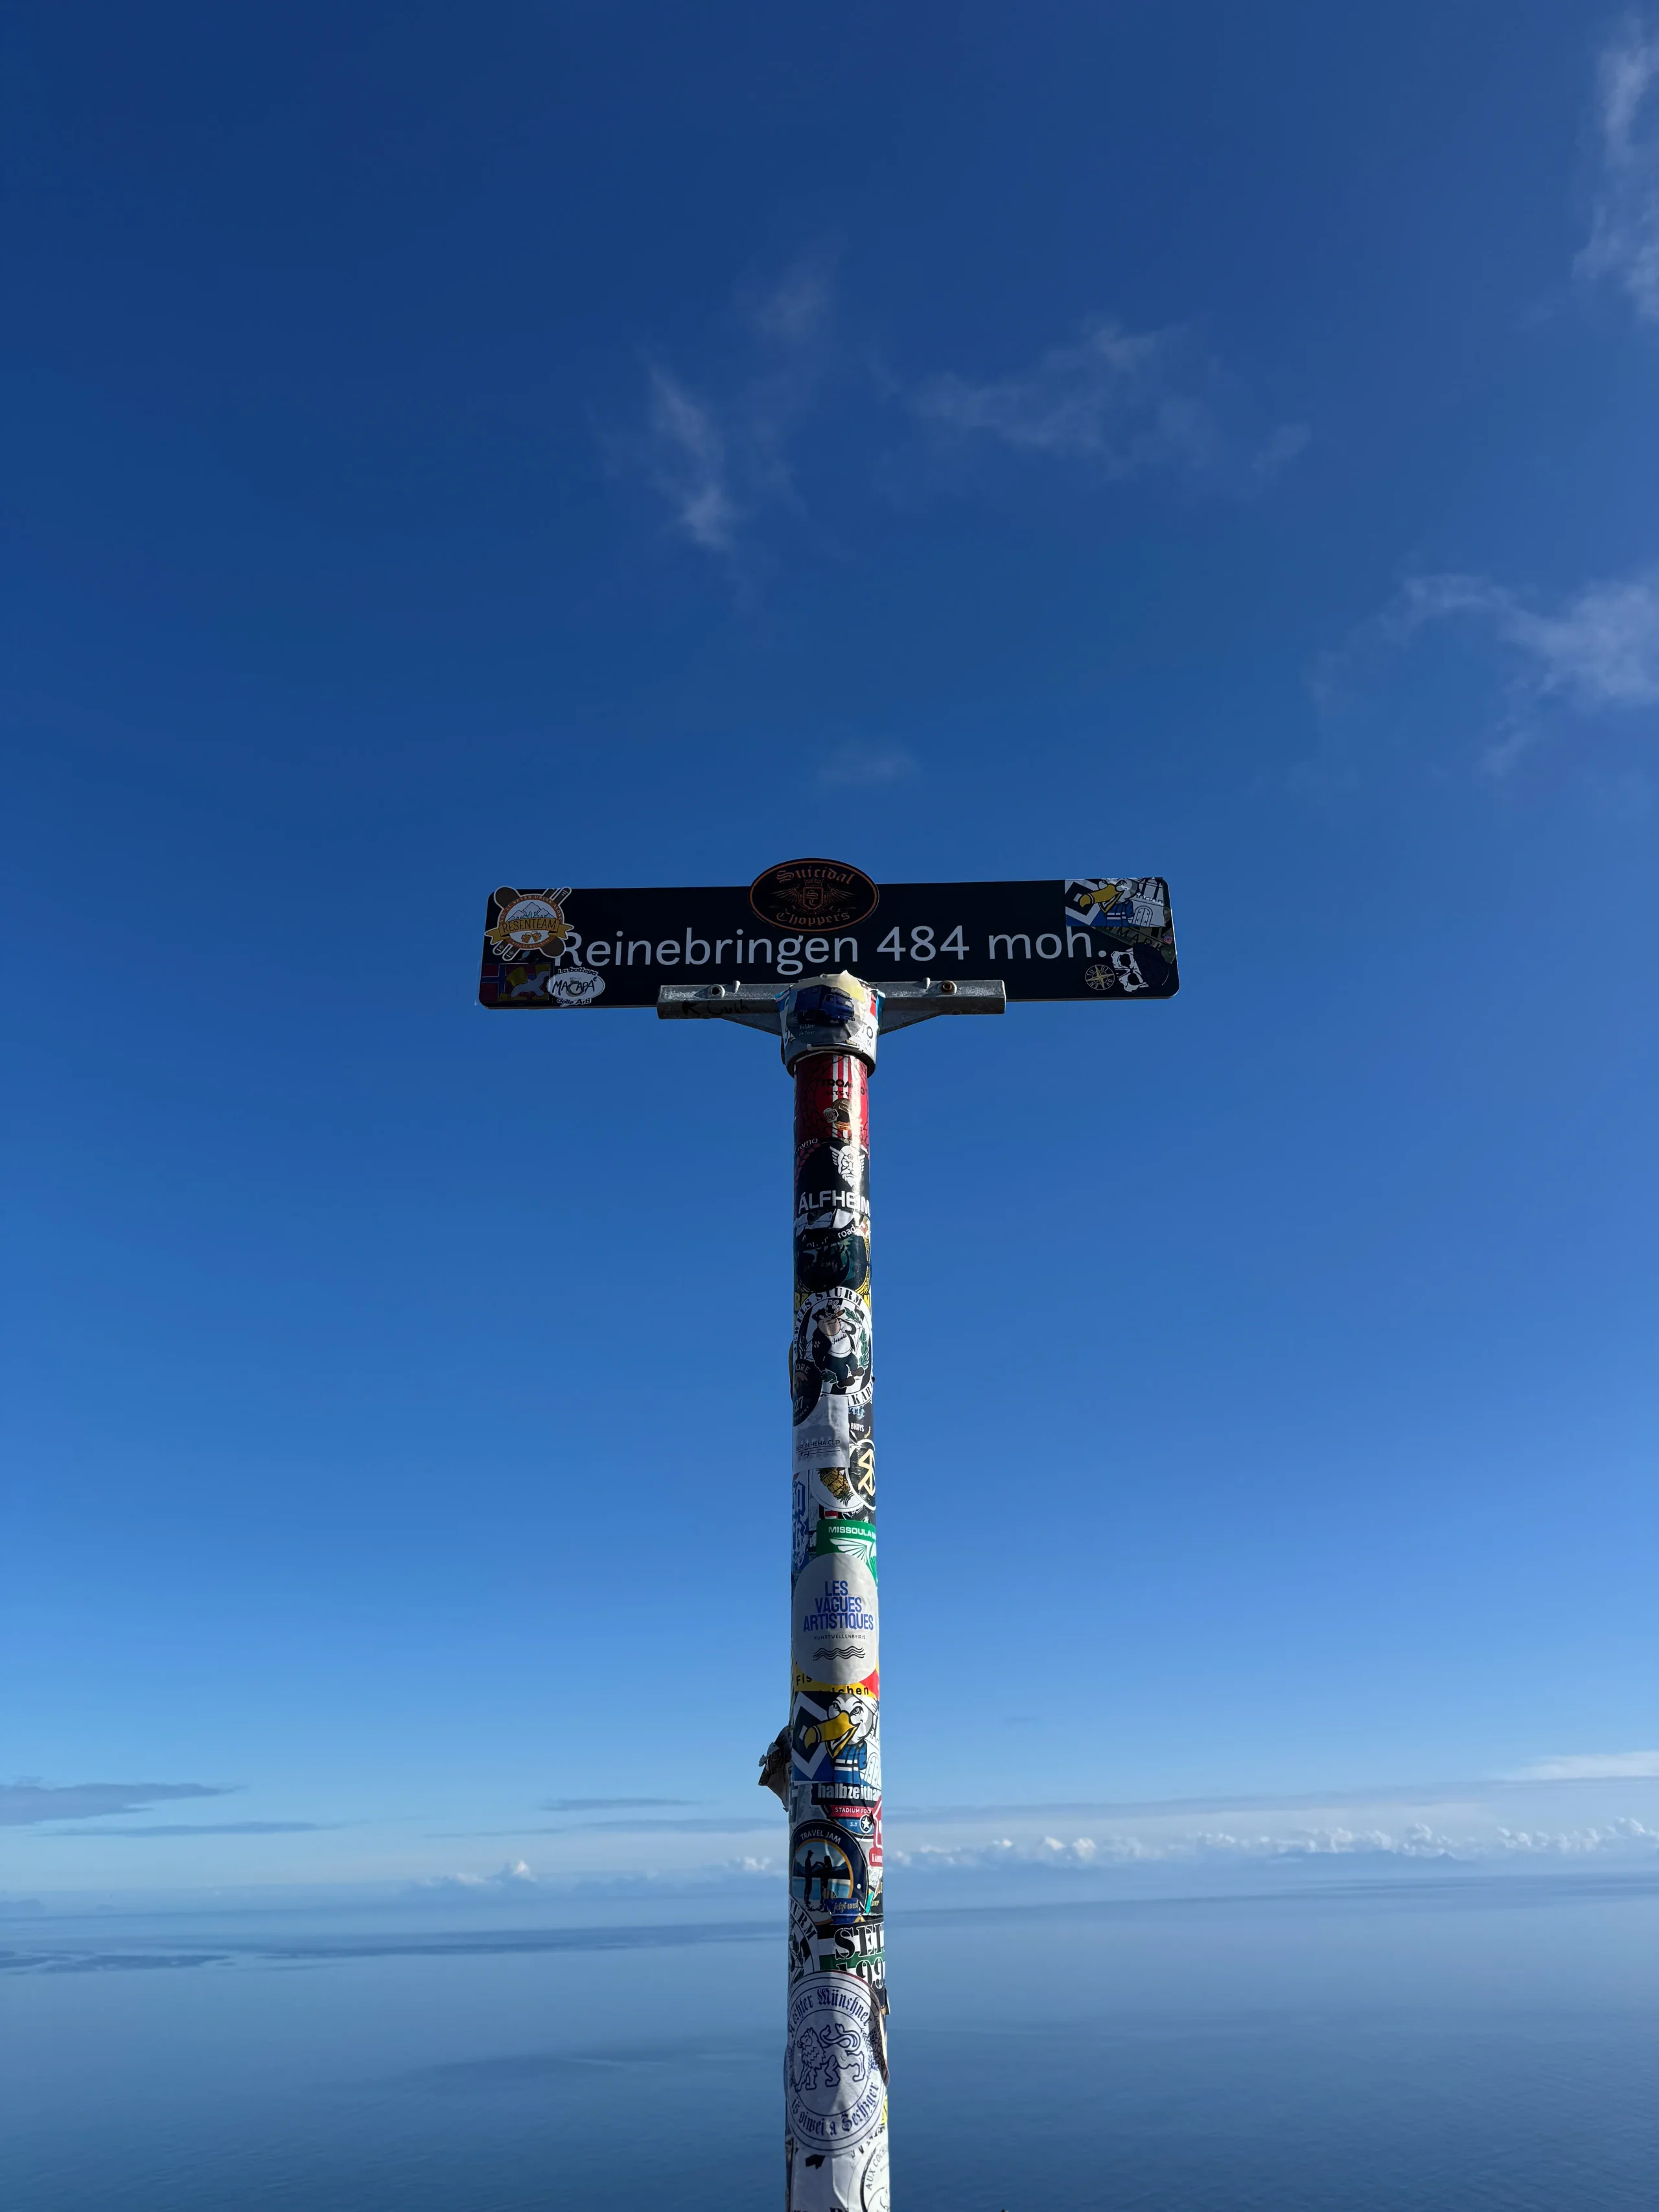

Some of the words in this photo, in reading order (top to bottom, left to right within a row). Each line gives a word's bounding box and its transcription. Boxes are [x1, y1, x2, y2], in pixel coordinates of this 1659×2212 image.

[502, 918, 558, 933] RESENTEAM
[555, 926, 859, 976] Reinebringen
[876, 924, 970, 962] 484
[988, 925, 1108, 960] moh.
[824, 1580, 848, 1597] LES
[815, 1596, 862, 1614] VAGUES
[803, 1612, 874, 1632] ARTISTIQUES
[800, 1829, 824, 1841] TRAVEL
[825, 1831, 842, 1845] JAM
[817, 1987, 872, 2027] Münchner
[866, 2167, 876, 2191] AUX
